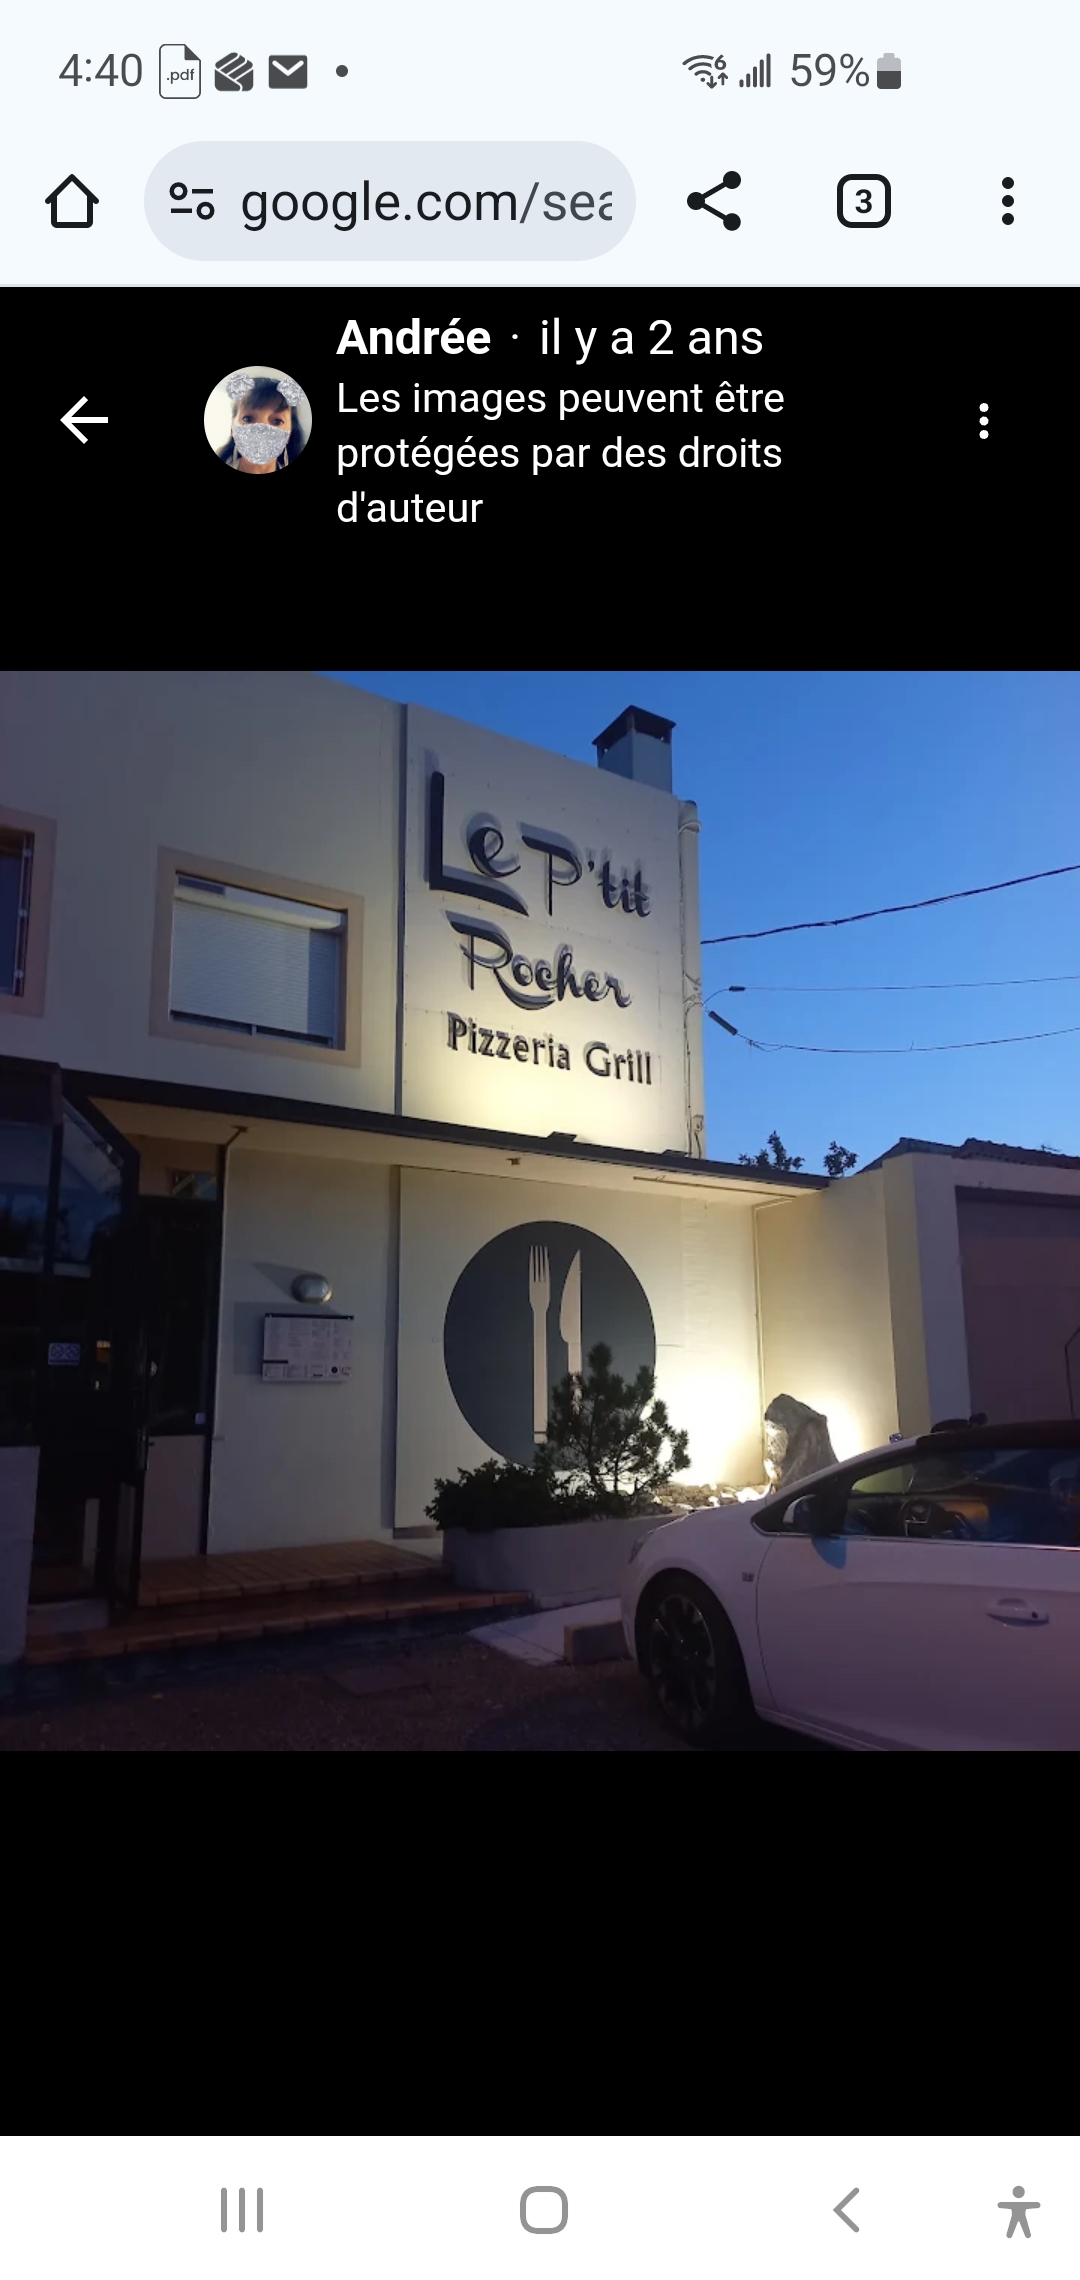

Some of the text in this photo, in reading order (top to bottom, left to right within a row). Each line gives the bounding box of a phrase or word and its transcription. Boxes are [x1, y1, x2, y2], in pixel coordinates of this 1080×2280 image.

[428, 770, 652, 918] Le P'tit
[449, 917, 632, 1012] Rocher
[446, 1012, 653, 1086] Pizzeria Grill
